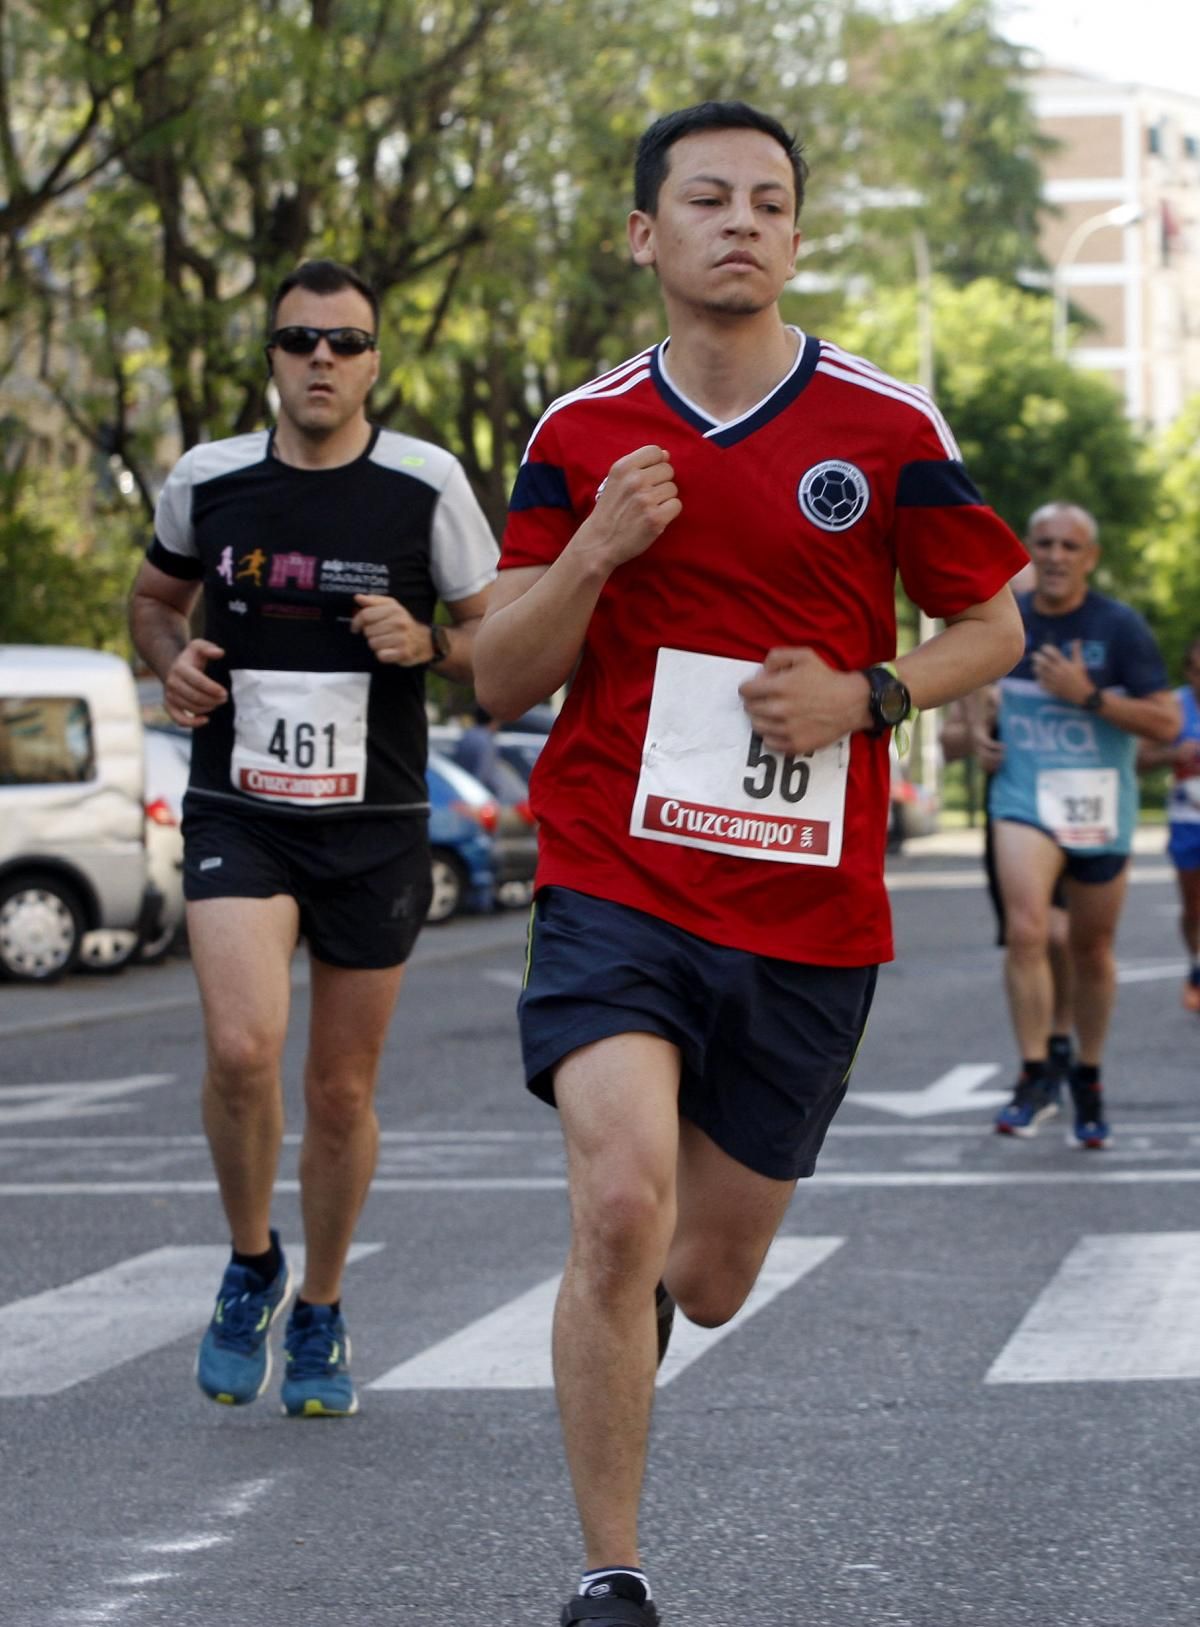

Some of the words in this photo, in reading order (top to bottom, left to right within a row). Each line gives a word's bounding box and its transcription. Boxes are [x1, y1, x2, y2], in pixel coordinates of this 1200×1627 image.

[267, 718, 336, 768] 461
[743, 726, 813, 803] 56
[247, 769, 336, 797] Cruzcampo
[660, 800, 794, 847] Cruzcampo
[799, 826, 814, 848] SIN
